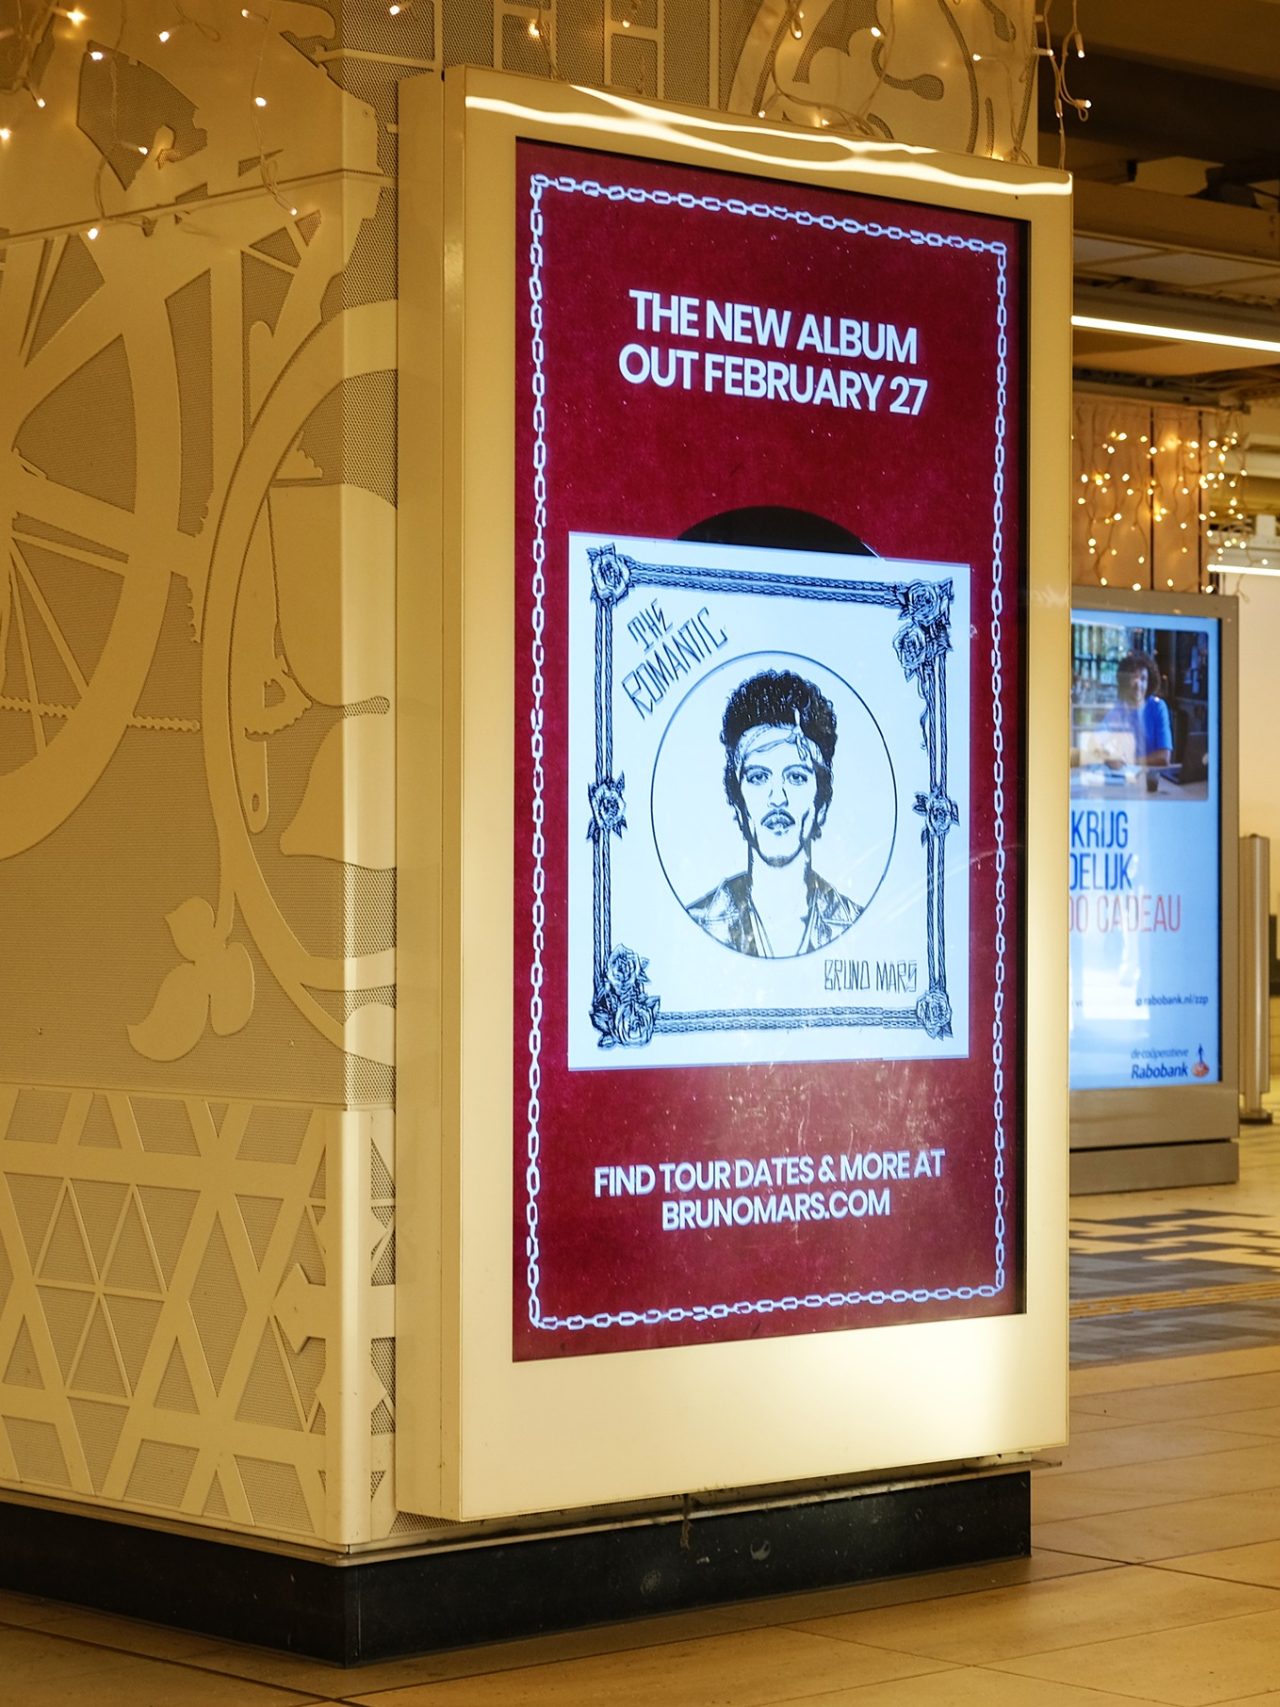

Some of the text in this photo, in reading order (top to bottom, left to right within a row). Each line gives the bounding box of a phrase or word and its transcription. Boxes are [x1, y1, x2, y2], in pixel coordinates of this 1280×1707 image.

[629, 288, 918, 365] THE NEW ALBUM
[618, 343, 928, 416] OUT FEBRUARY 27
[627, 597, 673, 655] THE
[621, 607, 728, 720] ROMANTIC
[1072, 811, 1128, 848] KRIJG
[1097, 895, 1181, 932] CADEAU
[824, 959, 917, 993] BRUNO MARS
[1131, 1062, 1188, 1079] Rabobank
[594, 1148, 946, 1197] FIND TOUR DATES & MORE AT
[662, 1188, 890, 1231] BRUNOMARS.COM
